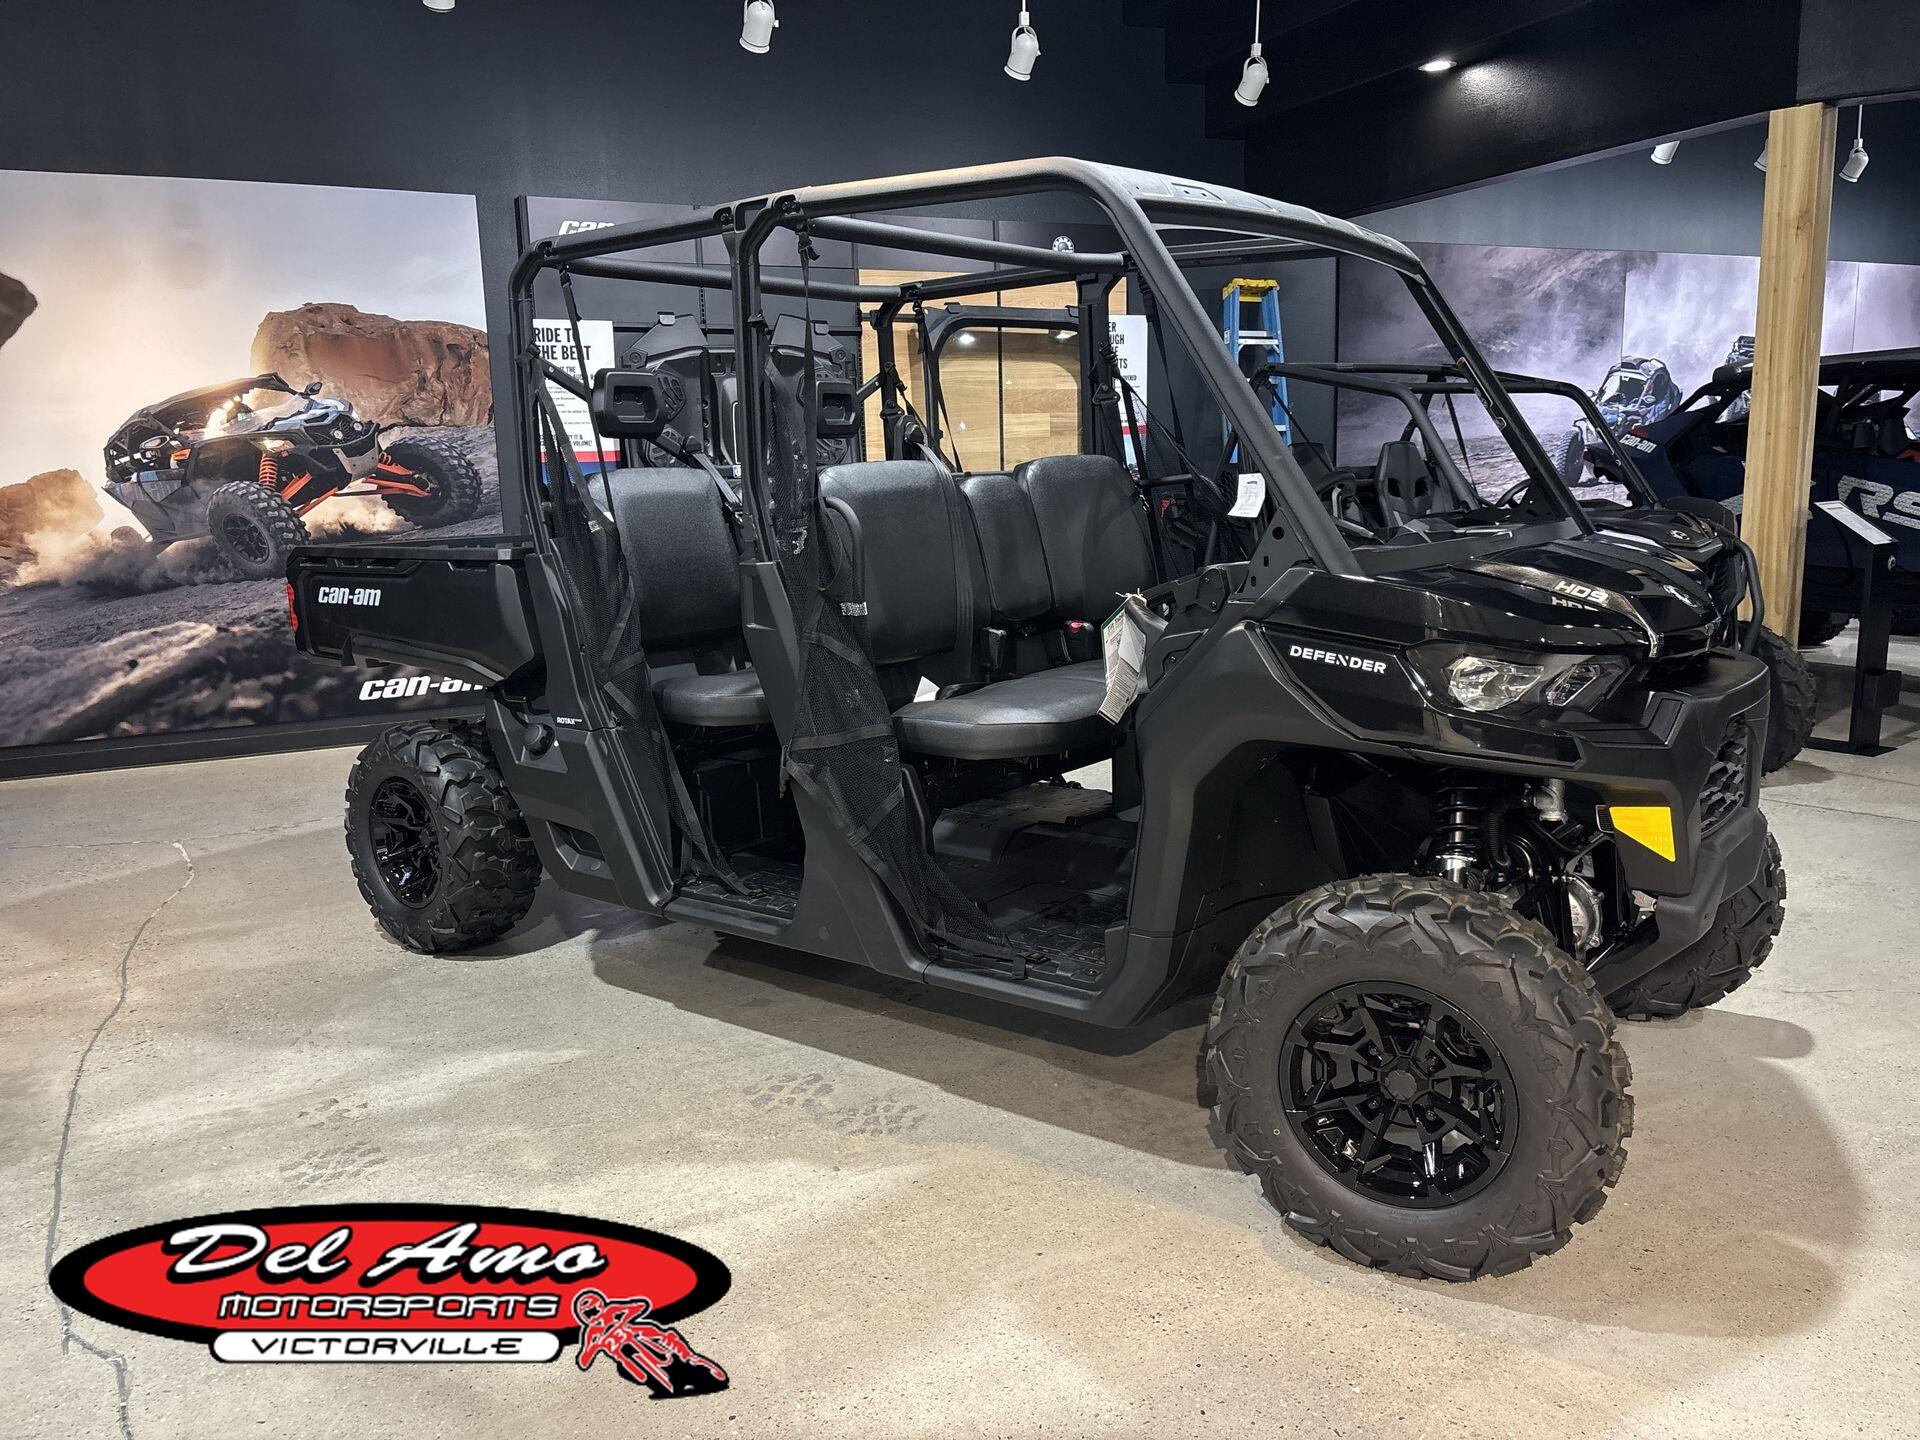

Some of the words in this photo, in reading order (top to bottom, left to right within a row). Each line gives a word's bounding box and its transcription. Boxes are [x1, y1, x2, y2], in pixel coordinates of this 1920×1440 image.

[533, 327, 561, 343] RIDE
[561, 345, 592, 361] BET
[1619, 433, 1658, 454] can-am
[318, 586, 382, 606] can-am
[1289, 645, 1387, 674] DEFENDER
